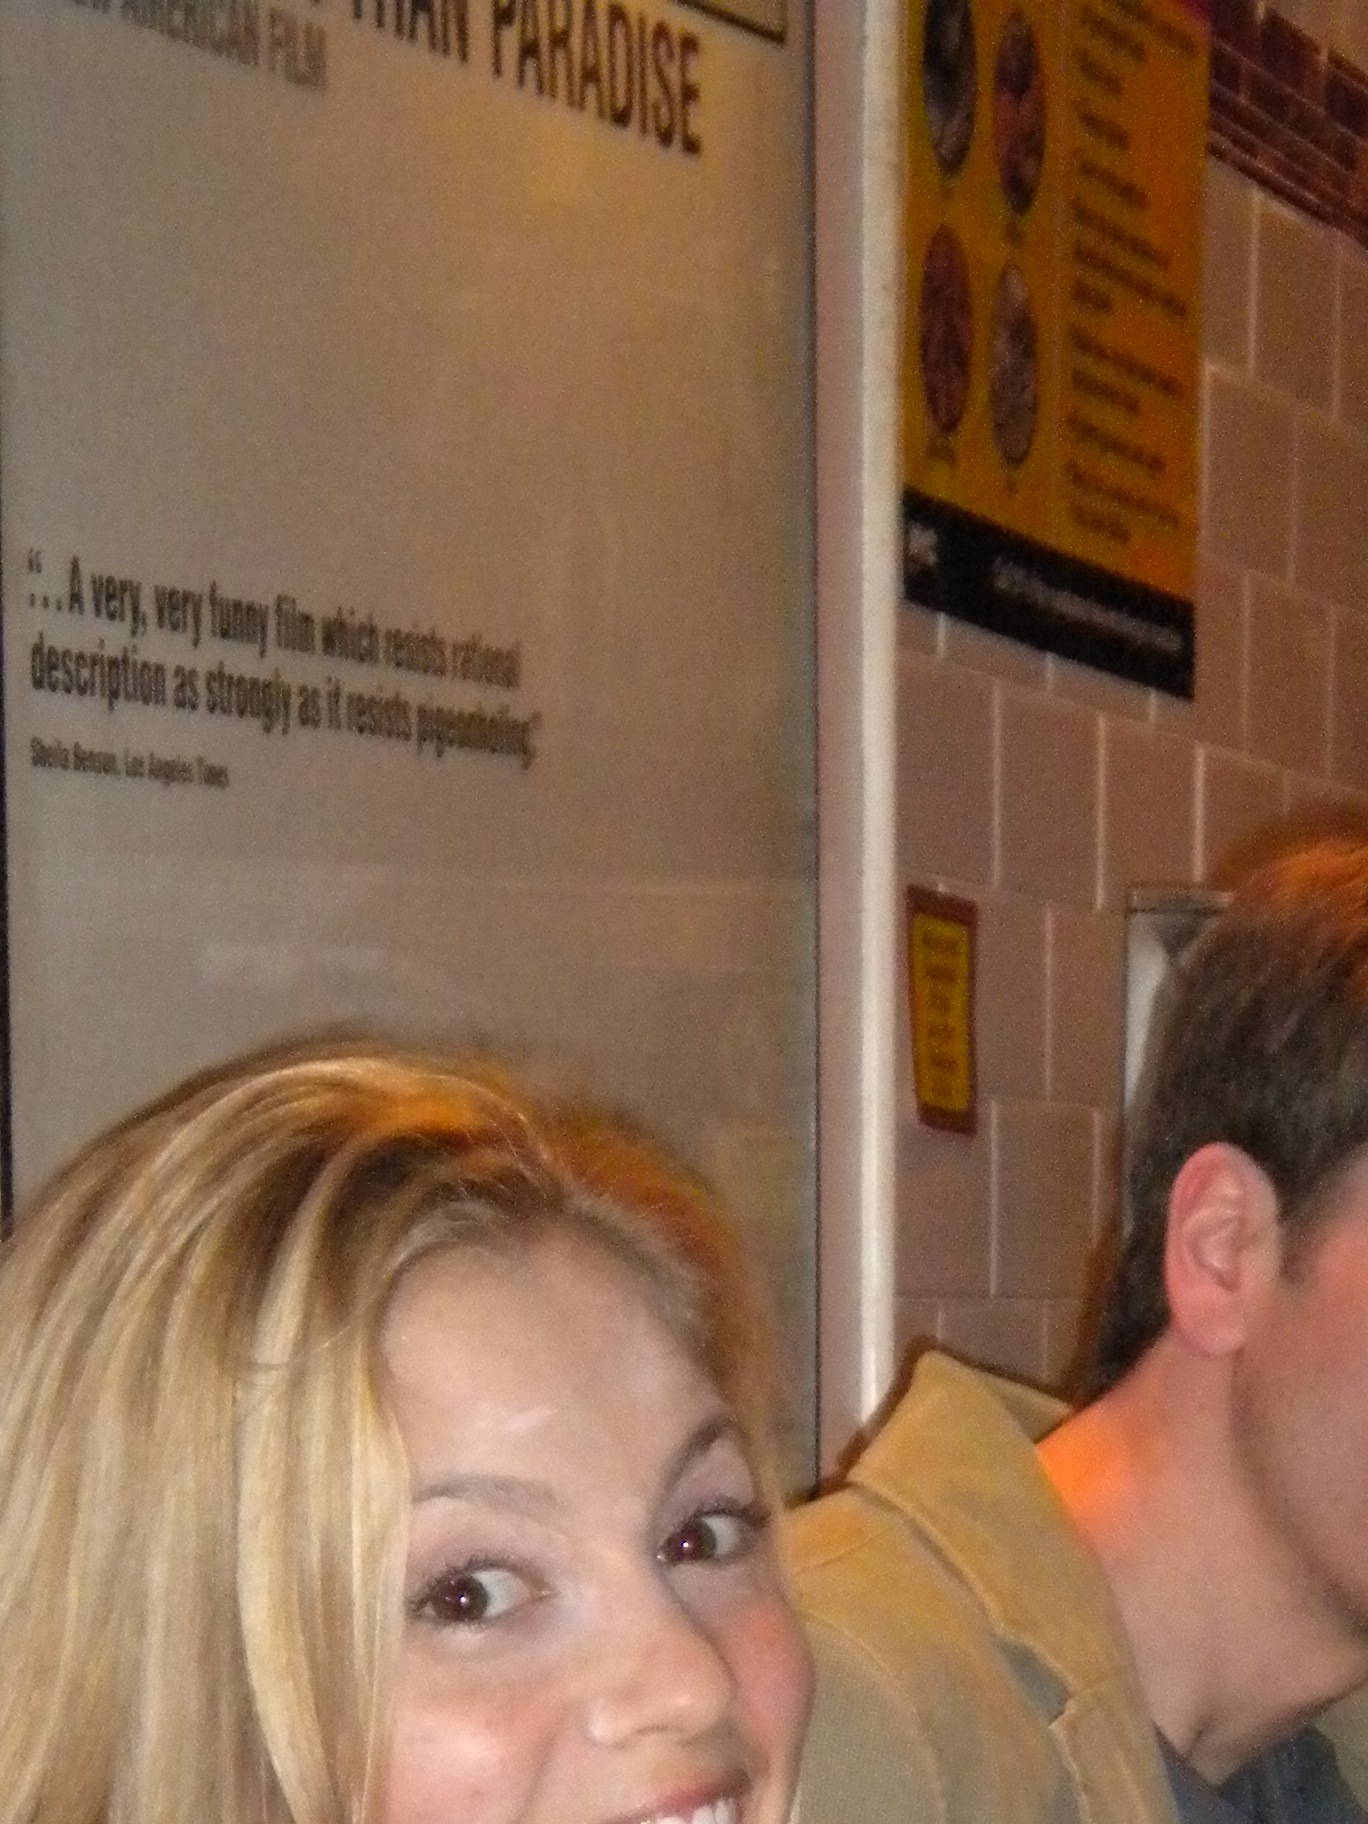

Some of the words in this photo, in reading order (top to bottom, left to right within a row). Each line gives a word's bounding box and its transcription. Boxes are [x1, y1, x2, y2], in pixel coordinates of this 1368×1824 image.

[490, 0, 702, 155] PARADISE
[91, 573, 147, 637] very,
[154, 583, 203, 648] very
[209, 580, 269, 658] funny
[30, 631, 167, 714] description
[173, 663, 200, 713] as
[206, 660, 292, 735] strongly
[297, 682, 322, 729] as
